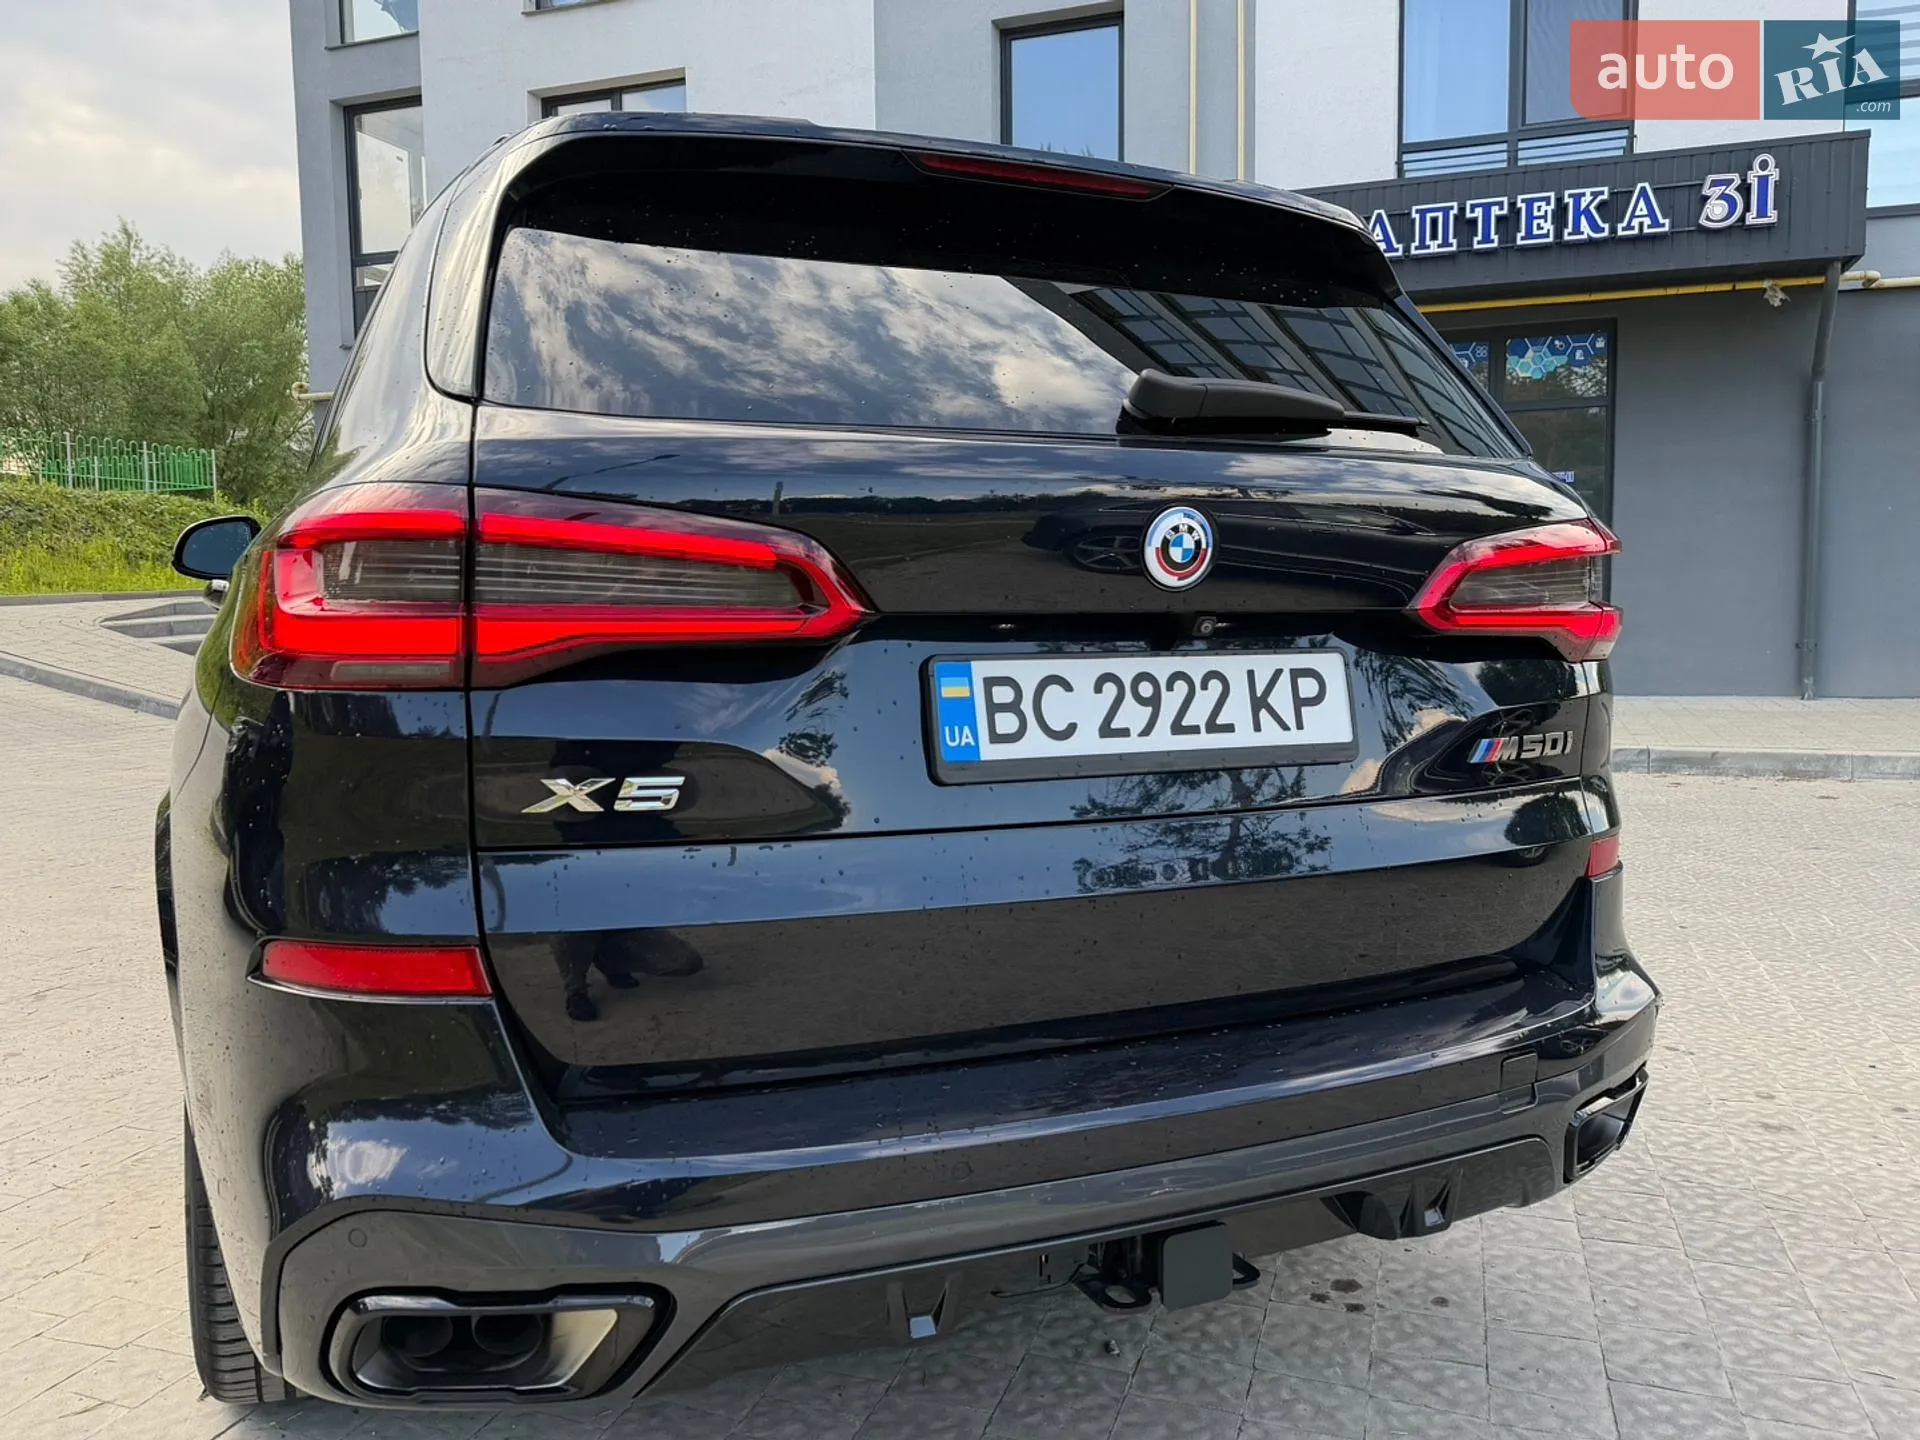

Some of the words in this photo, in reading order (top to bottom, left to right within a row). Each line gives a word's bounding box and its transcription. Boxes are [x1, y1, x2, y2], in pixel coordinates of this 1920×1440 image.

[1368, 182, 1670, 258] АПТЕКА
[1165, 523, 1200, 541] BMW
[983, 674, 1078, 744] BC
[1093, 669, 1235, 739] 2922
[1246, 667, 1327, 733] KP
[945, 725, 975, 747] UA
[521, 776, 685, 813] X5
